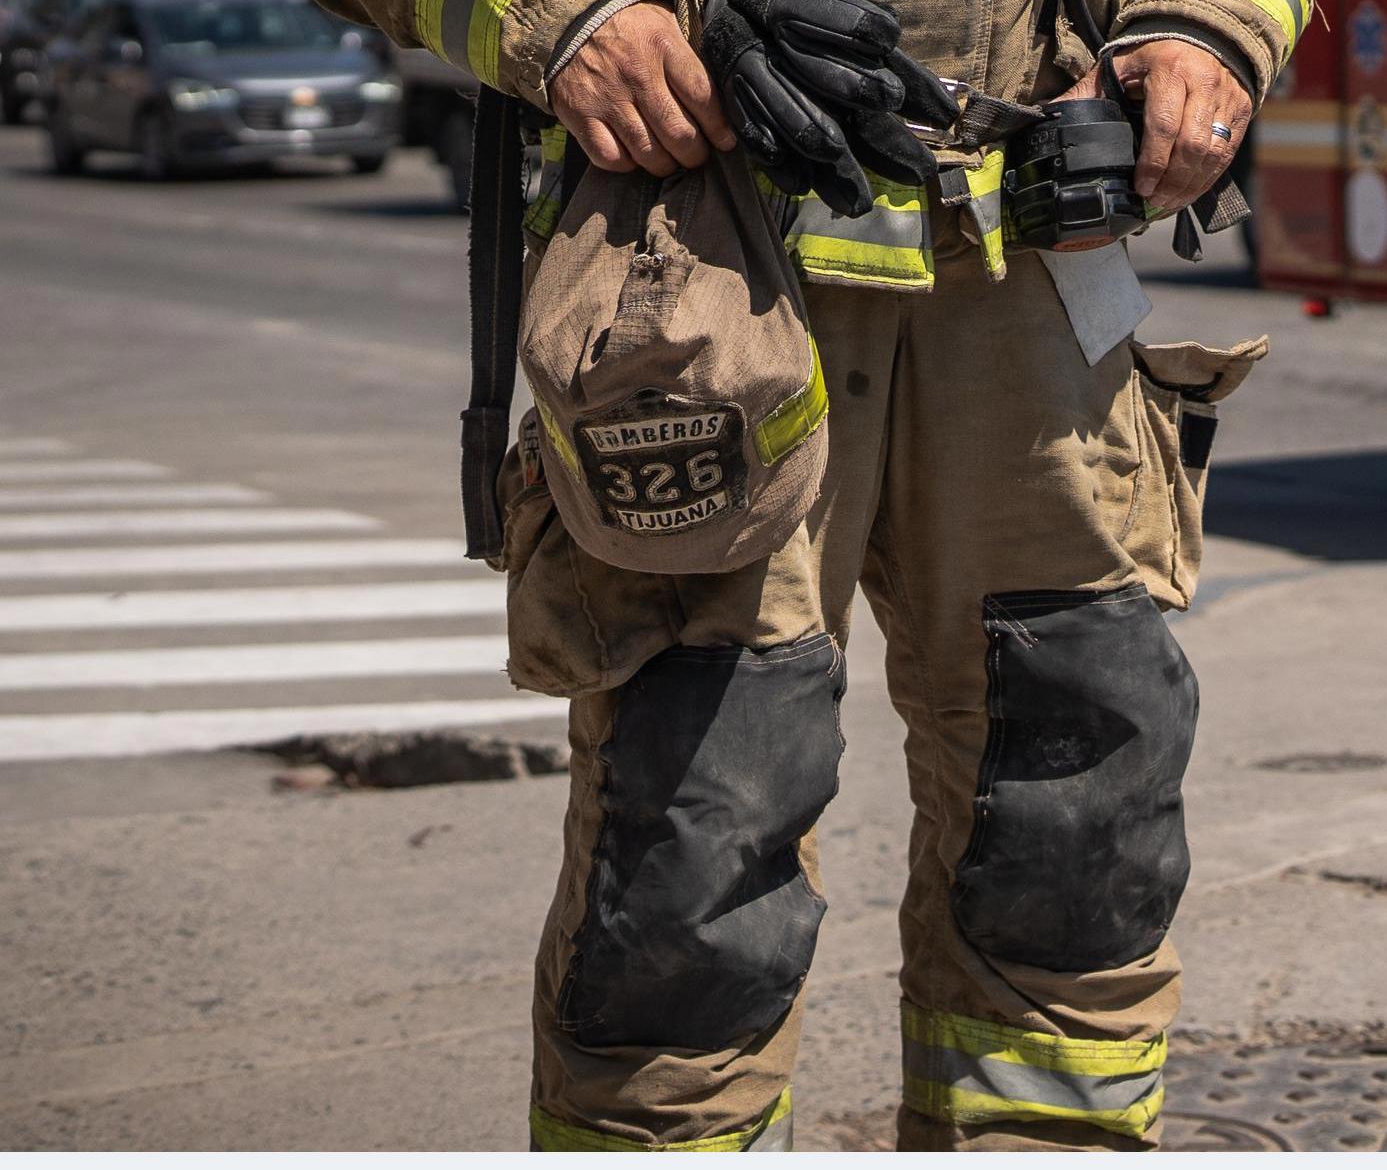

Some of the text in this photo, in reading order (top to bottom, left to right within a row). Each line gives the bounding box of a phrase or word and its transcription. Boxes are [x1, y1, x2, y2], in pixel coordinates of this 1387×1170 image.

[594, 415, 720, 449] BOMBEROS
[600, 448, 723, 503] 326
[624, 496, 719, 530] TIJUANA
